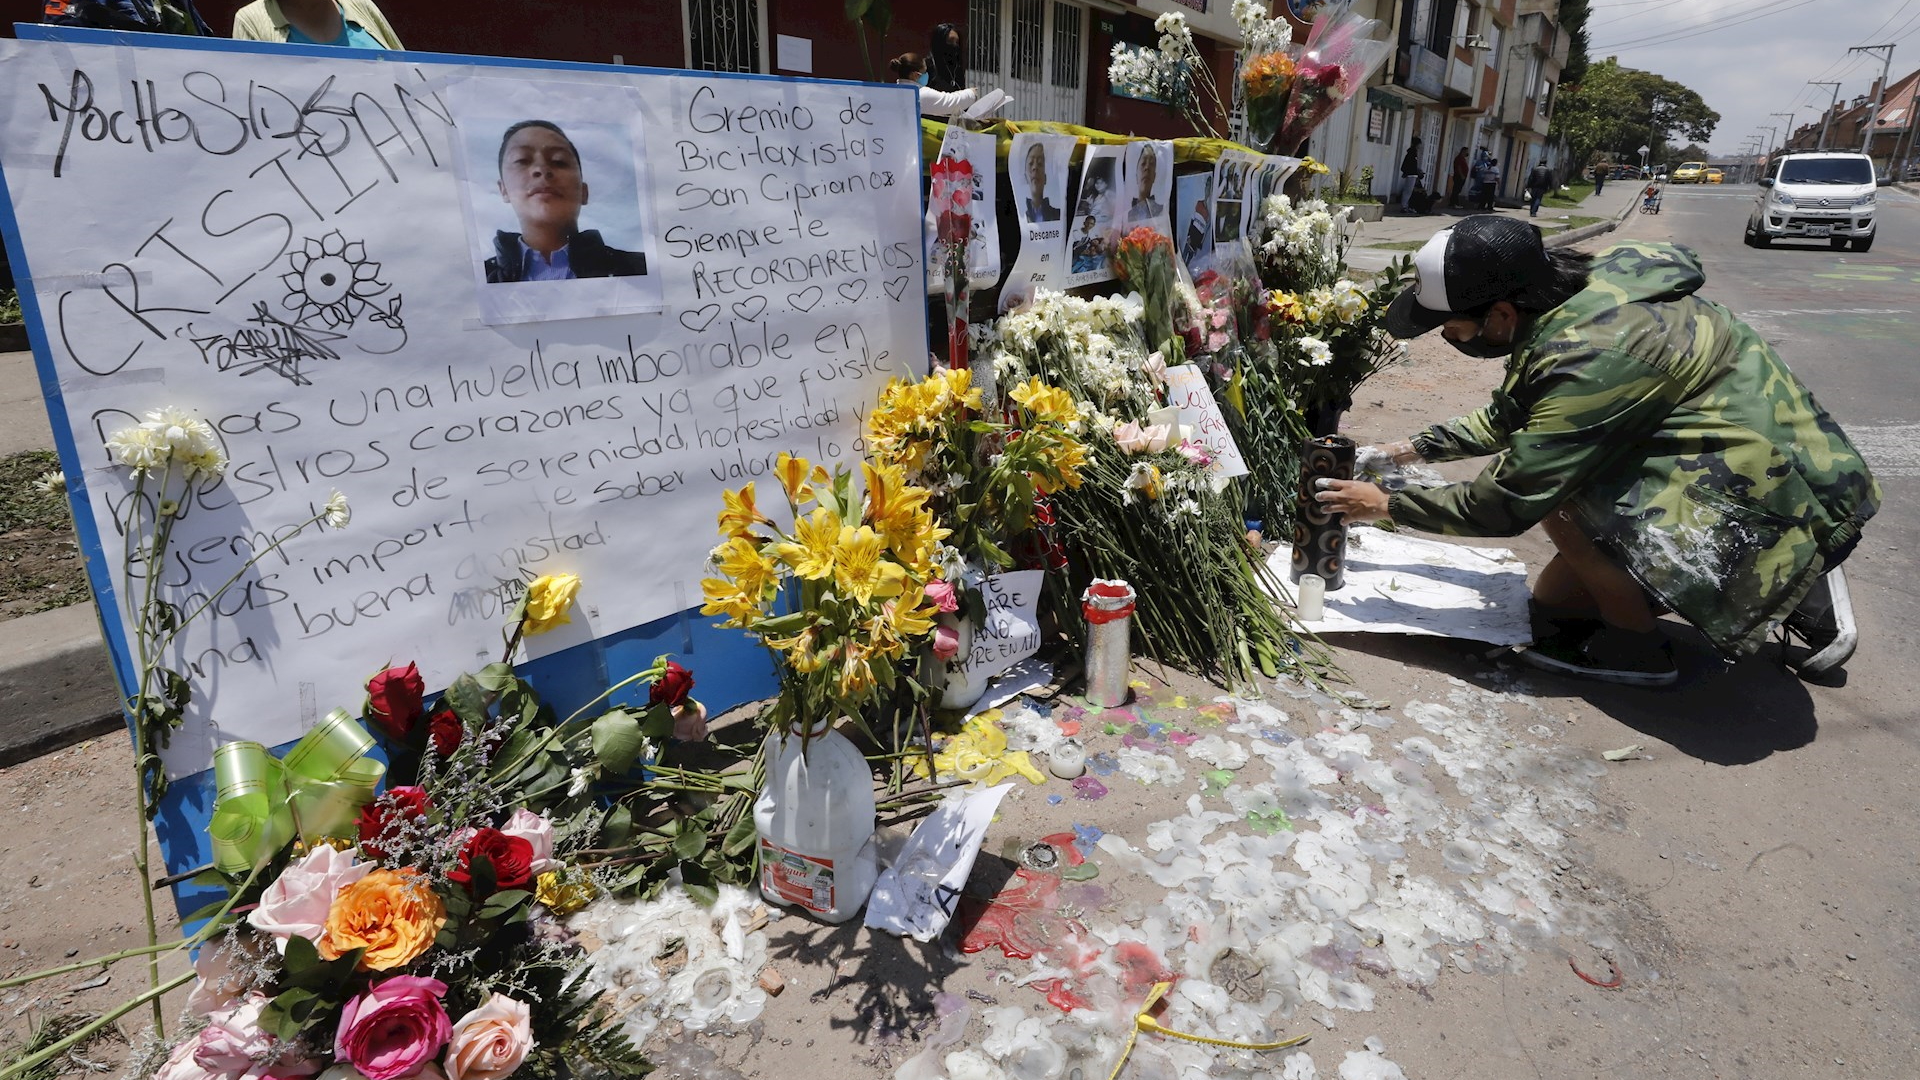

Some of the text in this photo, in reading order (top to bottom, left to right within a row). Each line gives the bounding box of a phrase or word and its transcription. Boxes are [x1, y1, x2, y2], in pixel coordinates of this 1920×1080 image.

[689, 86, 874, 134] Gremio de
[675, 128, 885, 172] Bicitaxistas
[676, 183, 749, 211] San
[59, 68, 457, 376] CRISTIAN
[665, 209, 829, 258] Siempre te
[1029, 229, 1060, 242] Descanse
[1030, 272, 1046, 283] Paz
[1040, 253, 1050, 263] en
[448, 338, 580, 403] huella
[814, 322, 868, 353] en
[409, 394, 624, 451] corazones
[642, 386, 694, 436] ya
[713, 374, 780, 418] que
[799, 347, 892, 407] fuiste
[392, 466, 451, 507] de
[852, 400, 865, 441] y
[817, 436, 842, 462] lo
[294, 573, 436, 639] buena
[975, 578, 1003, 594] TE
[998, 642, 1018, 659] EN
